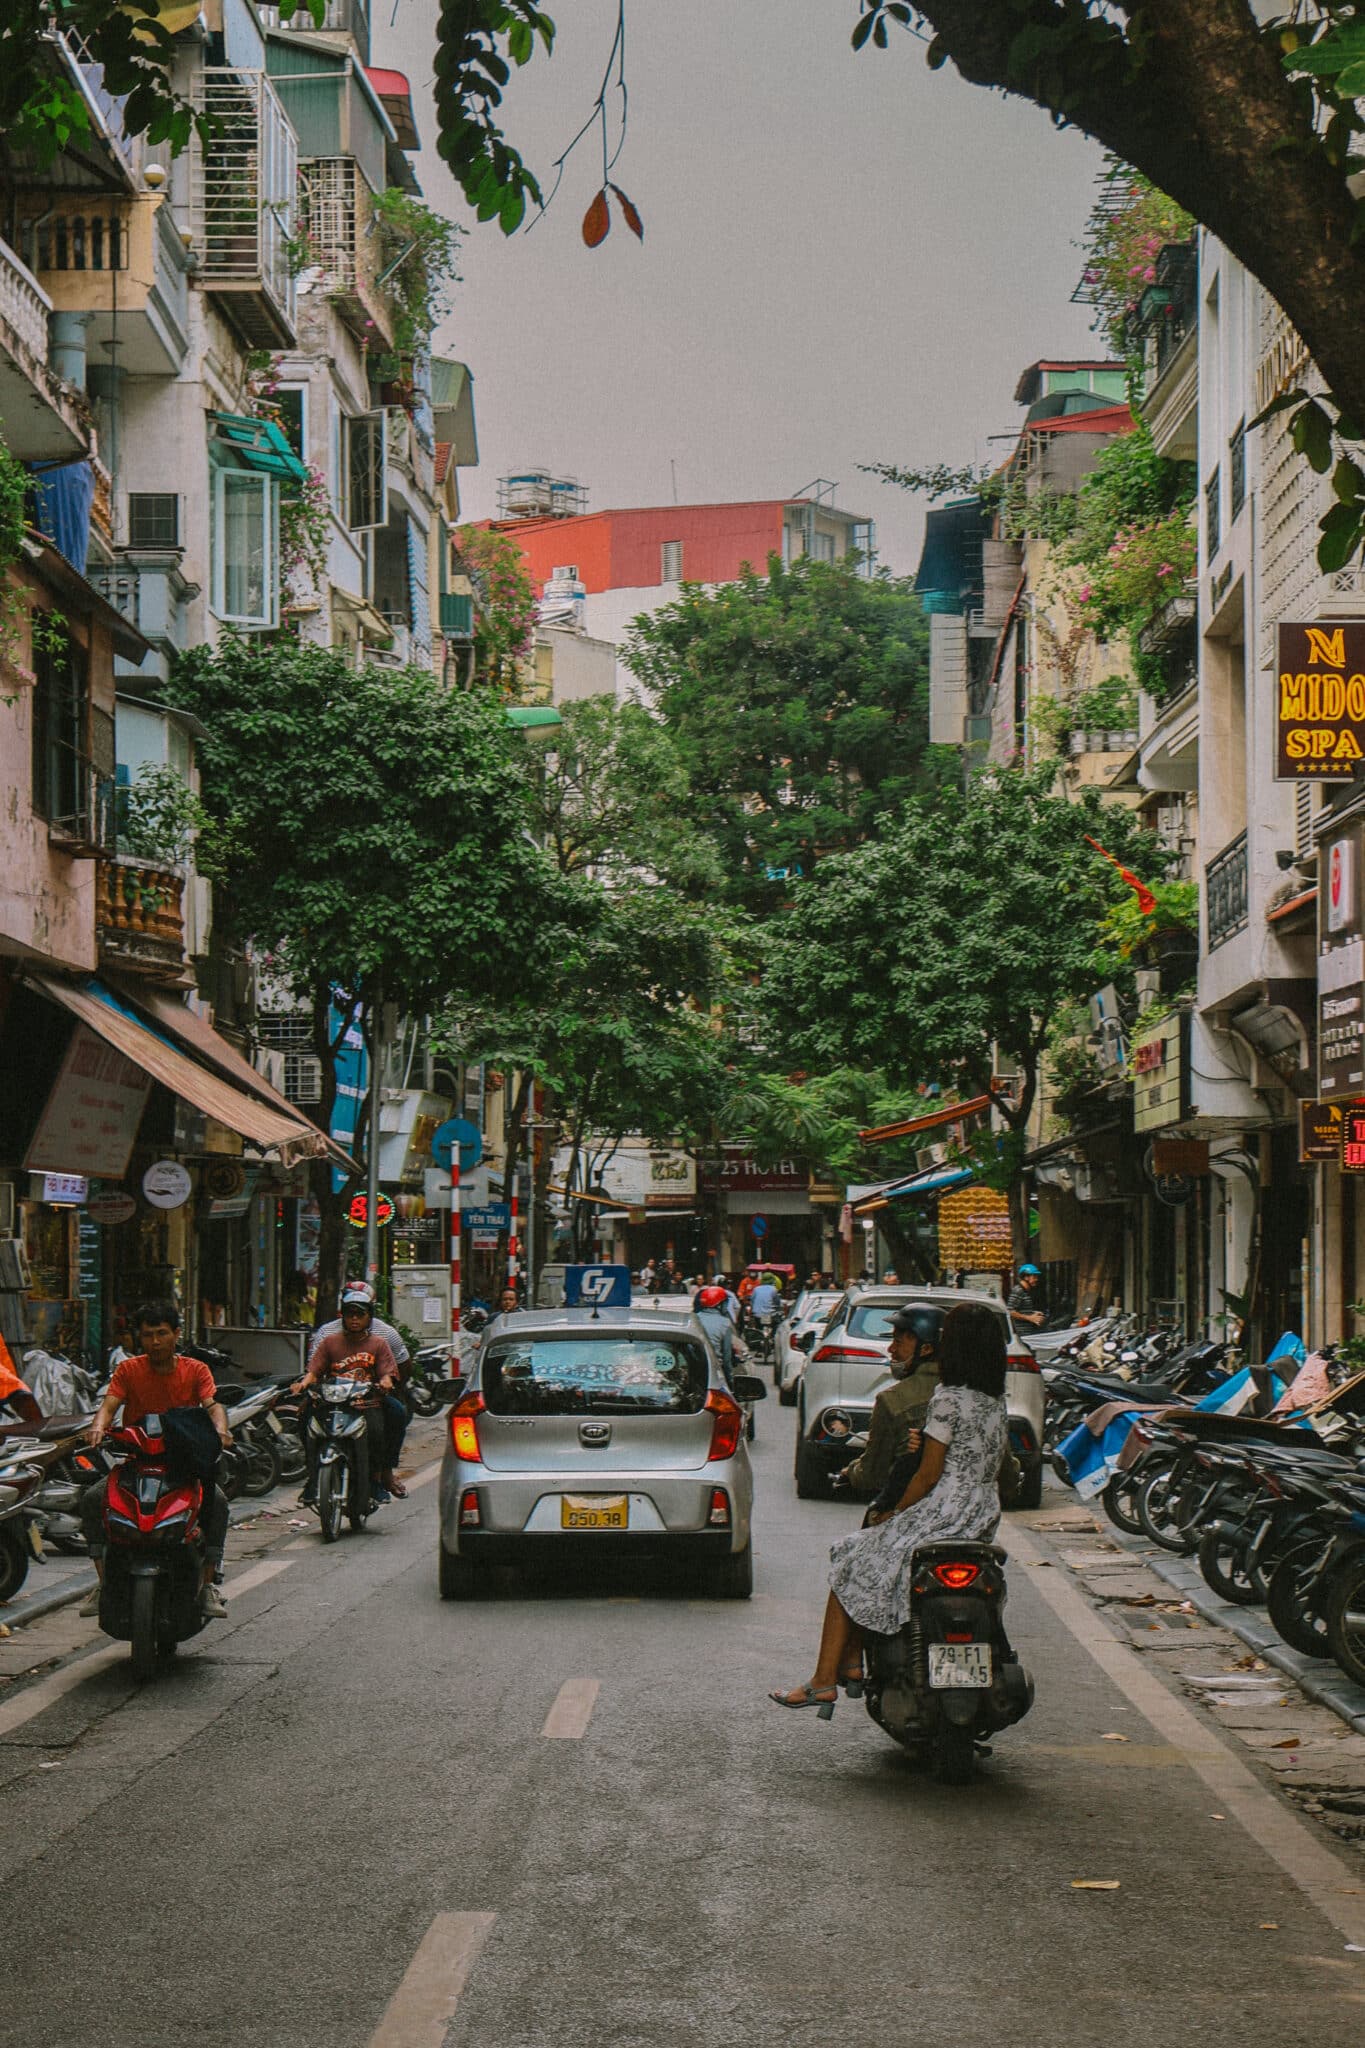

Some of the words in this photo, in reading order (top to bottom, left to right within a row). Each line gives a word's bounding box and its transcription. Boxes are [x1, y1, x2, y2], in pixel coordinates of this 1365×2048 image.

[1280, 673, 1365, 722] MIDO
[1286, 729, 1363, 759] SPA
[721, 1160, 739, 1175] 25
[581, 1270, 616, 1302] G7
[939, 1647, 980, 1664] 29-F1
